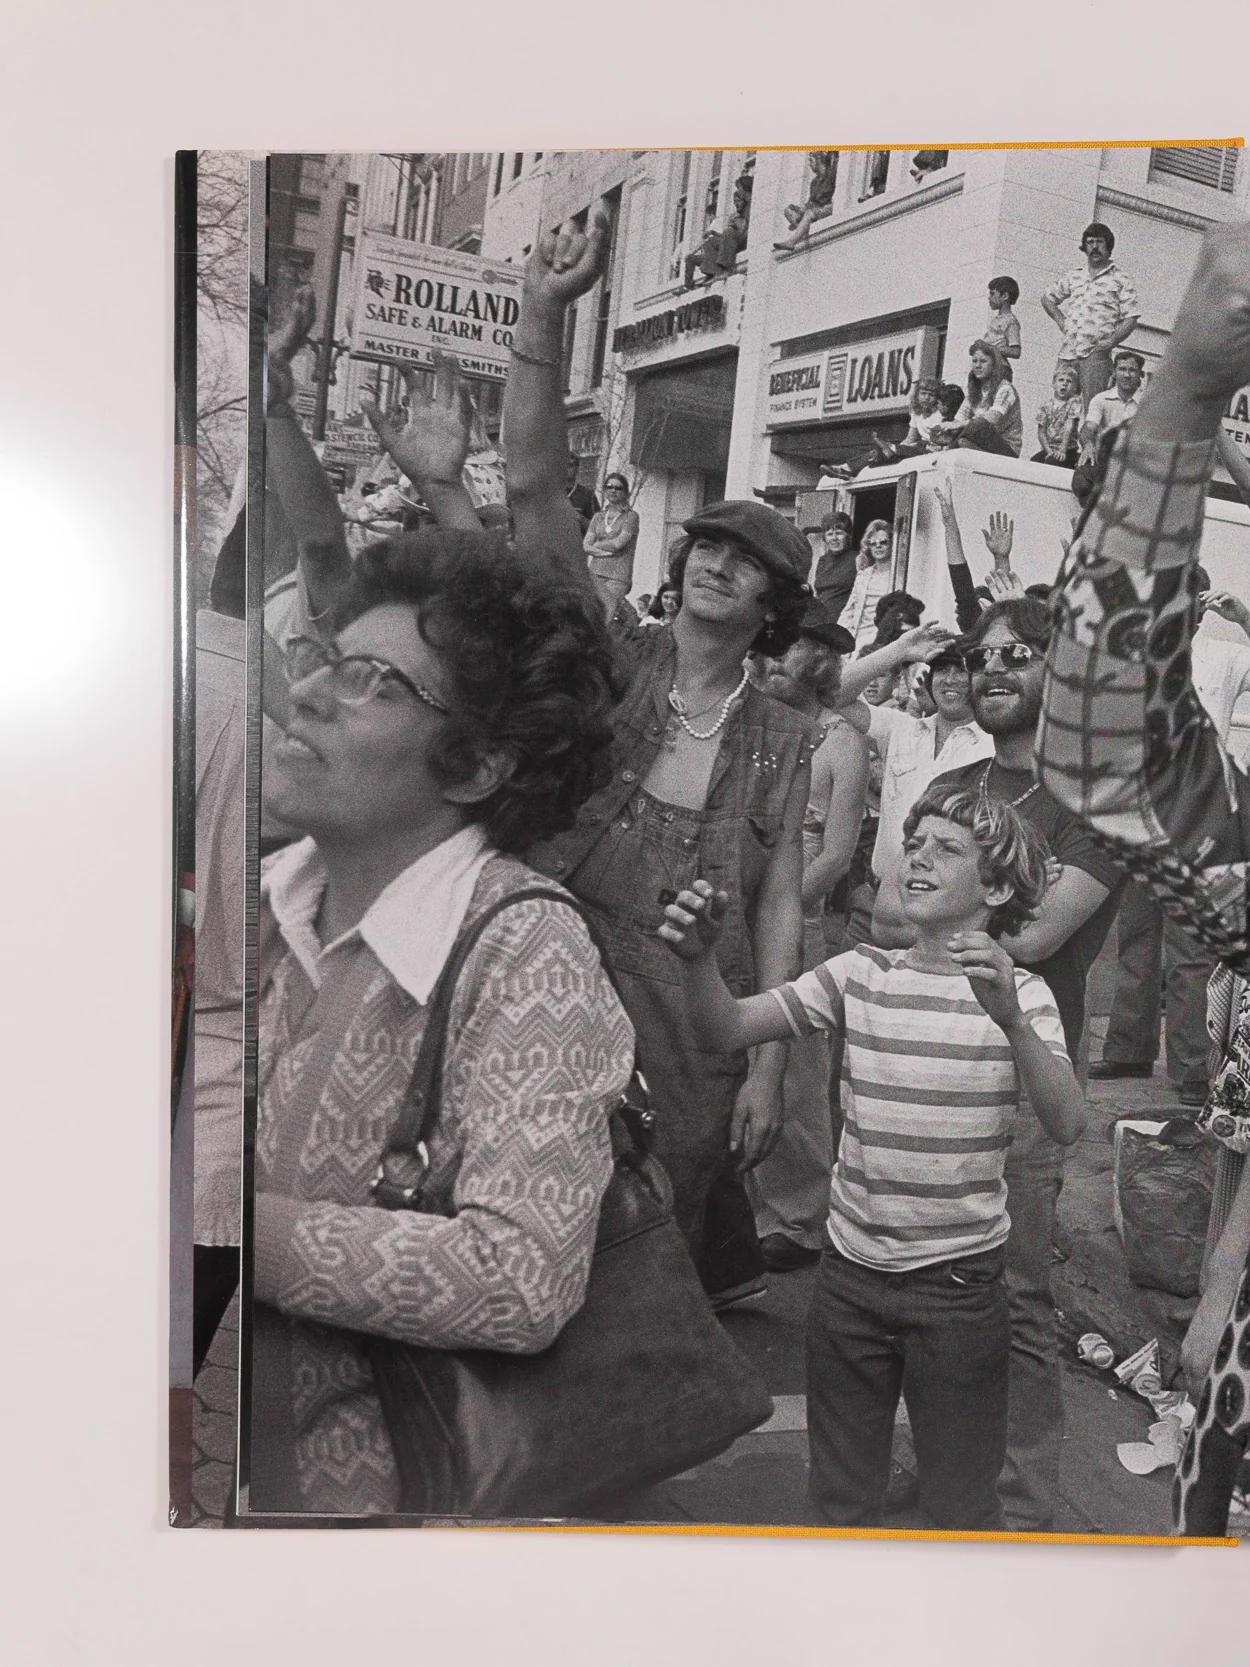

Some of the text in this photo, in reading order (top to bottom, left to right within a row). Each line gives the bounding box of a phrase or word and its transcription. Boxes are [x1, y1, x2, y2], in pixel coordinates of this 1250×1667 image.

[392, 273, 520, 326] ROLLAND
[365, 303, 408, 326] SAFE
[411, 317, 423, 329] &
[425, 315, 484, 341] ALARM
[364, 340, 420, 359] MASTER
[768, 365, 821, 396] BENEFICIAL
[845, 345, 916, 404] LOANS
